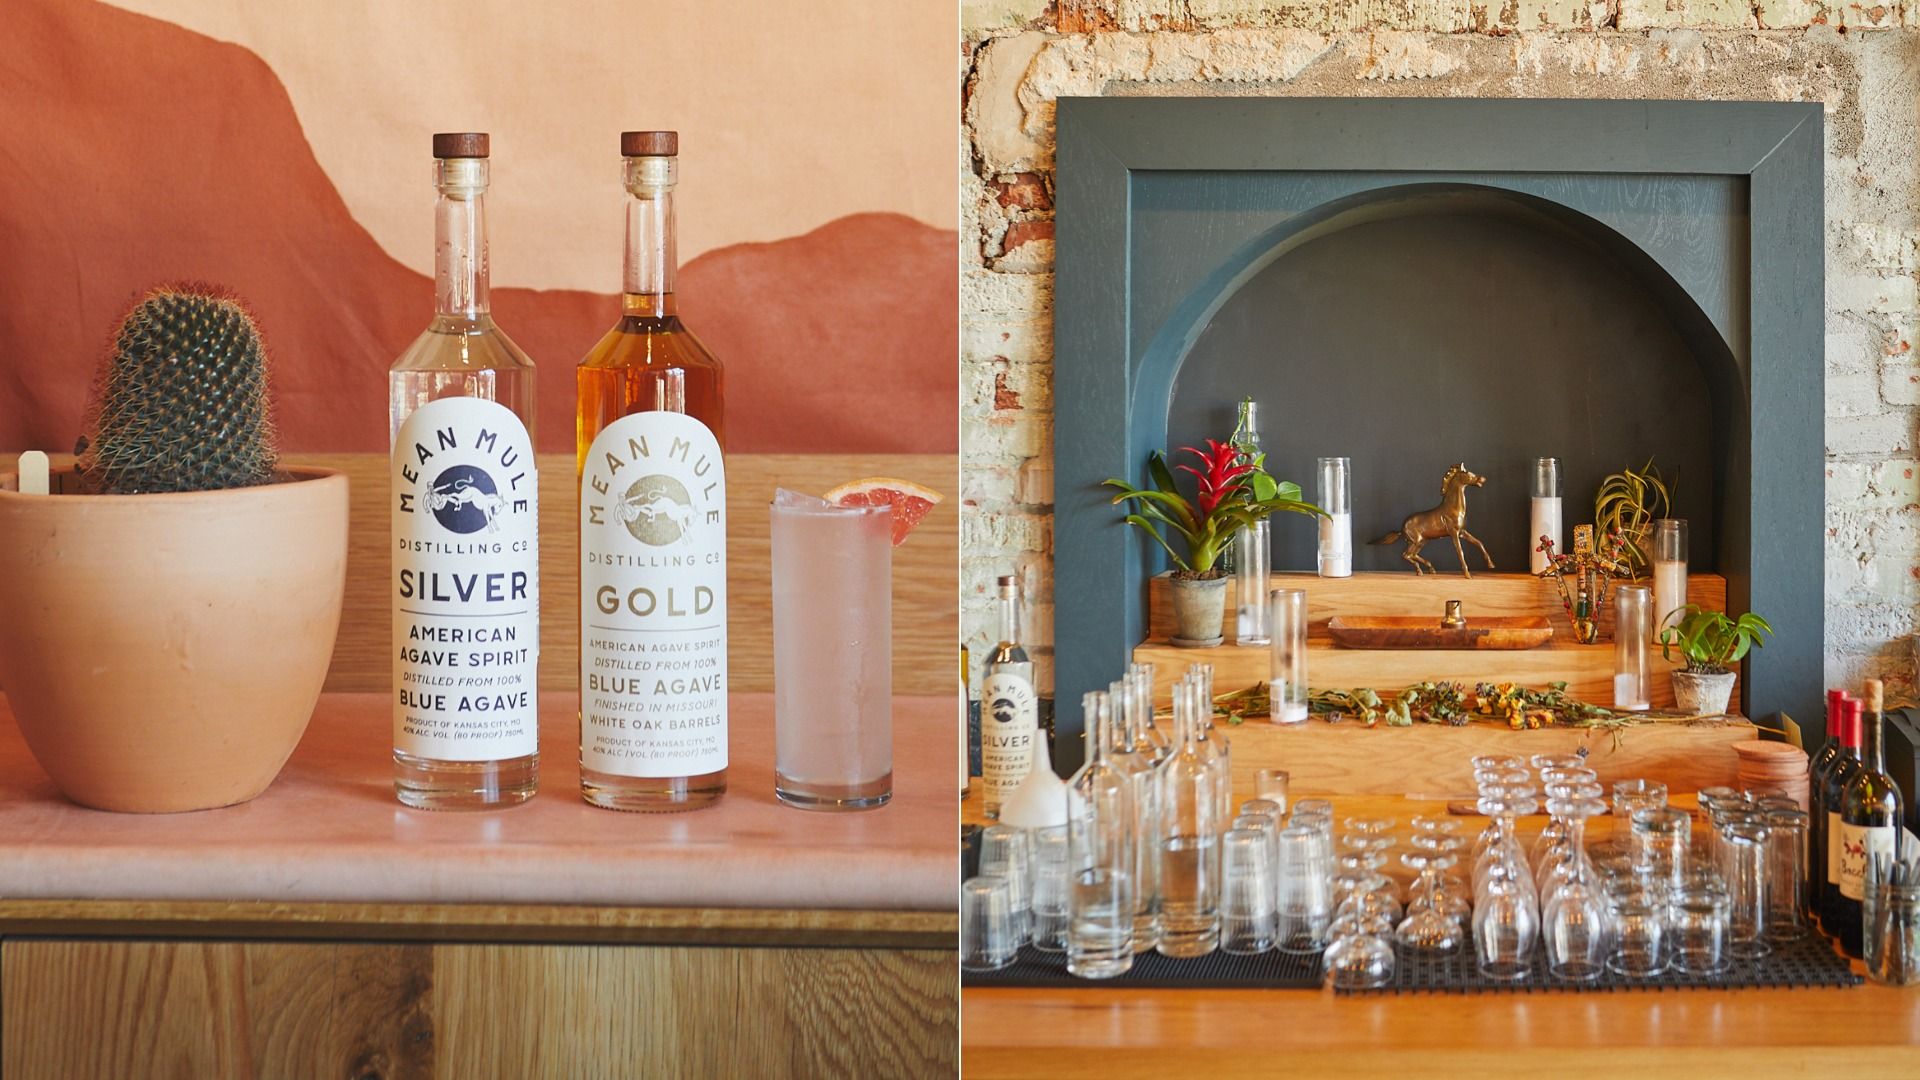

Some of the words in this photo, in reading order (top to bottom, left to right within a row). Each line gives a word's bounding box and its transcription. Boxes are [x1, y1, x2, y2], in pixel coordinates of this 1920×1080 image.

[400, 427, 457, 513] MEAN
[475, 428, 527, 514] MULE
[589, 435, 650, 525] MEAN
[668, 436, 719, 525] MULE
[400, 538, 502, 554] DISTILLING
[589, 552, 696, 567] DISTILLING
[400, 569, 528, 602] SILVER
[596, 585, 714, 617] GOLD
[409, 624, 516, 643] AMERICAN
[589, 639, 645, 652] AMERICAN
[651, 643, 690, 652] AGAVE
[694, 638, 721, 651] SPIRIT
[400, 646, 459, 667] AGAVE
[468, 648, 528, 667] SPIRIT
[594, 656, 651, 671] DISTILLED
[655, 661, 691, 671] FROM
[693, 657, 717, 669] 100%
[403, 671, 454, 687] DISTILLED
[458, 675, 493, 687] FROM
[497, 674, 522, 686] 100%
[589, 673, 641, 695] BLUE
[653, 673, 721, 696] AGAVE
[400, 689, 446, 711] BLUE
[458, 691, 528, 712] AGAVE
[594, 698, 645, 713] FINISHED
[648, 703, 662, 713] IN
[665, 698, 718, 712] MISSOURI
[405, 715, 437, 728] PRODUCT
[440, 721, 450, 729] OF
[453, 721, 489, 729] KANSAS
[510, 718, 521, 726] MO
[589, 714, 626, 729] WHITE
[632, 719, 663, 730] OAK
[669, 714, 721, 730] BARRELS
[415, 728, 430, 737] ALC
[596, 735, 631, 746] PRODUCT
[635, 739, 646, 747] OF
[650, 739, 685, 748] KANSAS
[706, 735, 716, 743] MO
[983, 734, 1030, 748] SILVER
[606, 748, 622, 757] ALC
